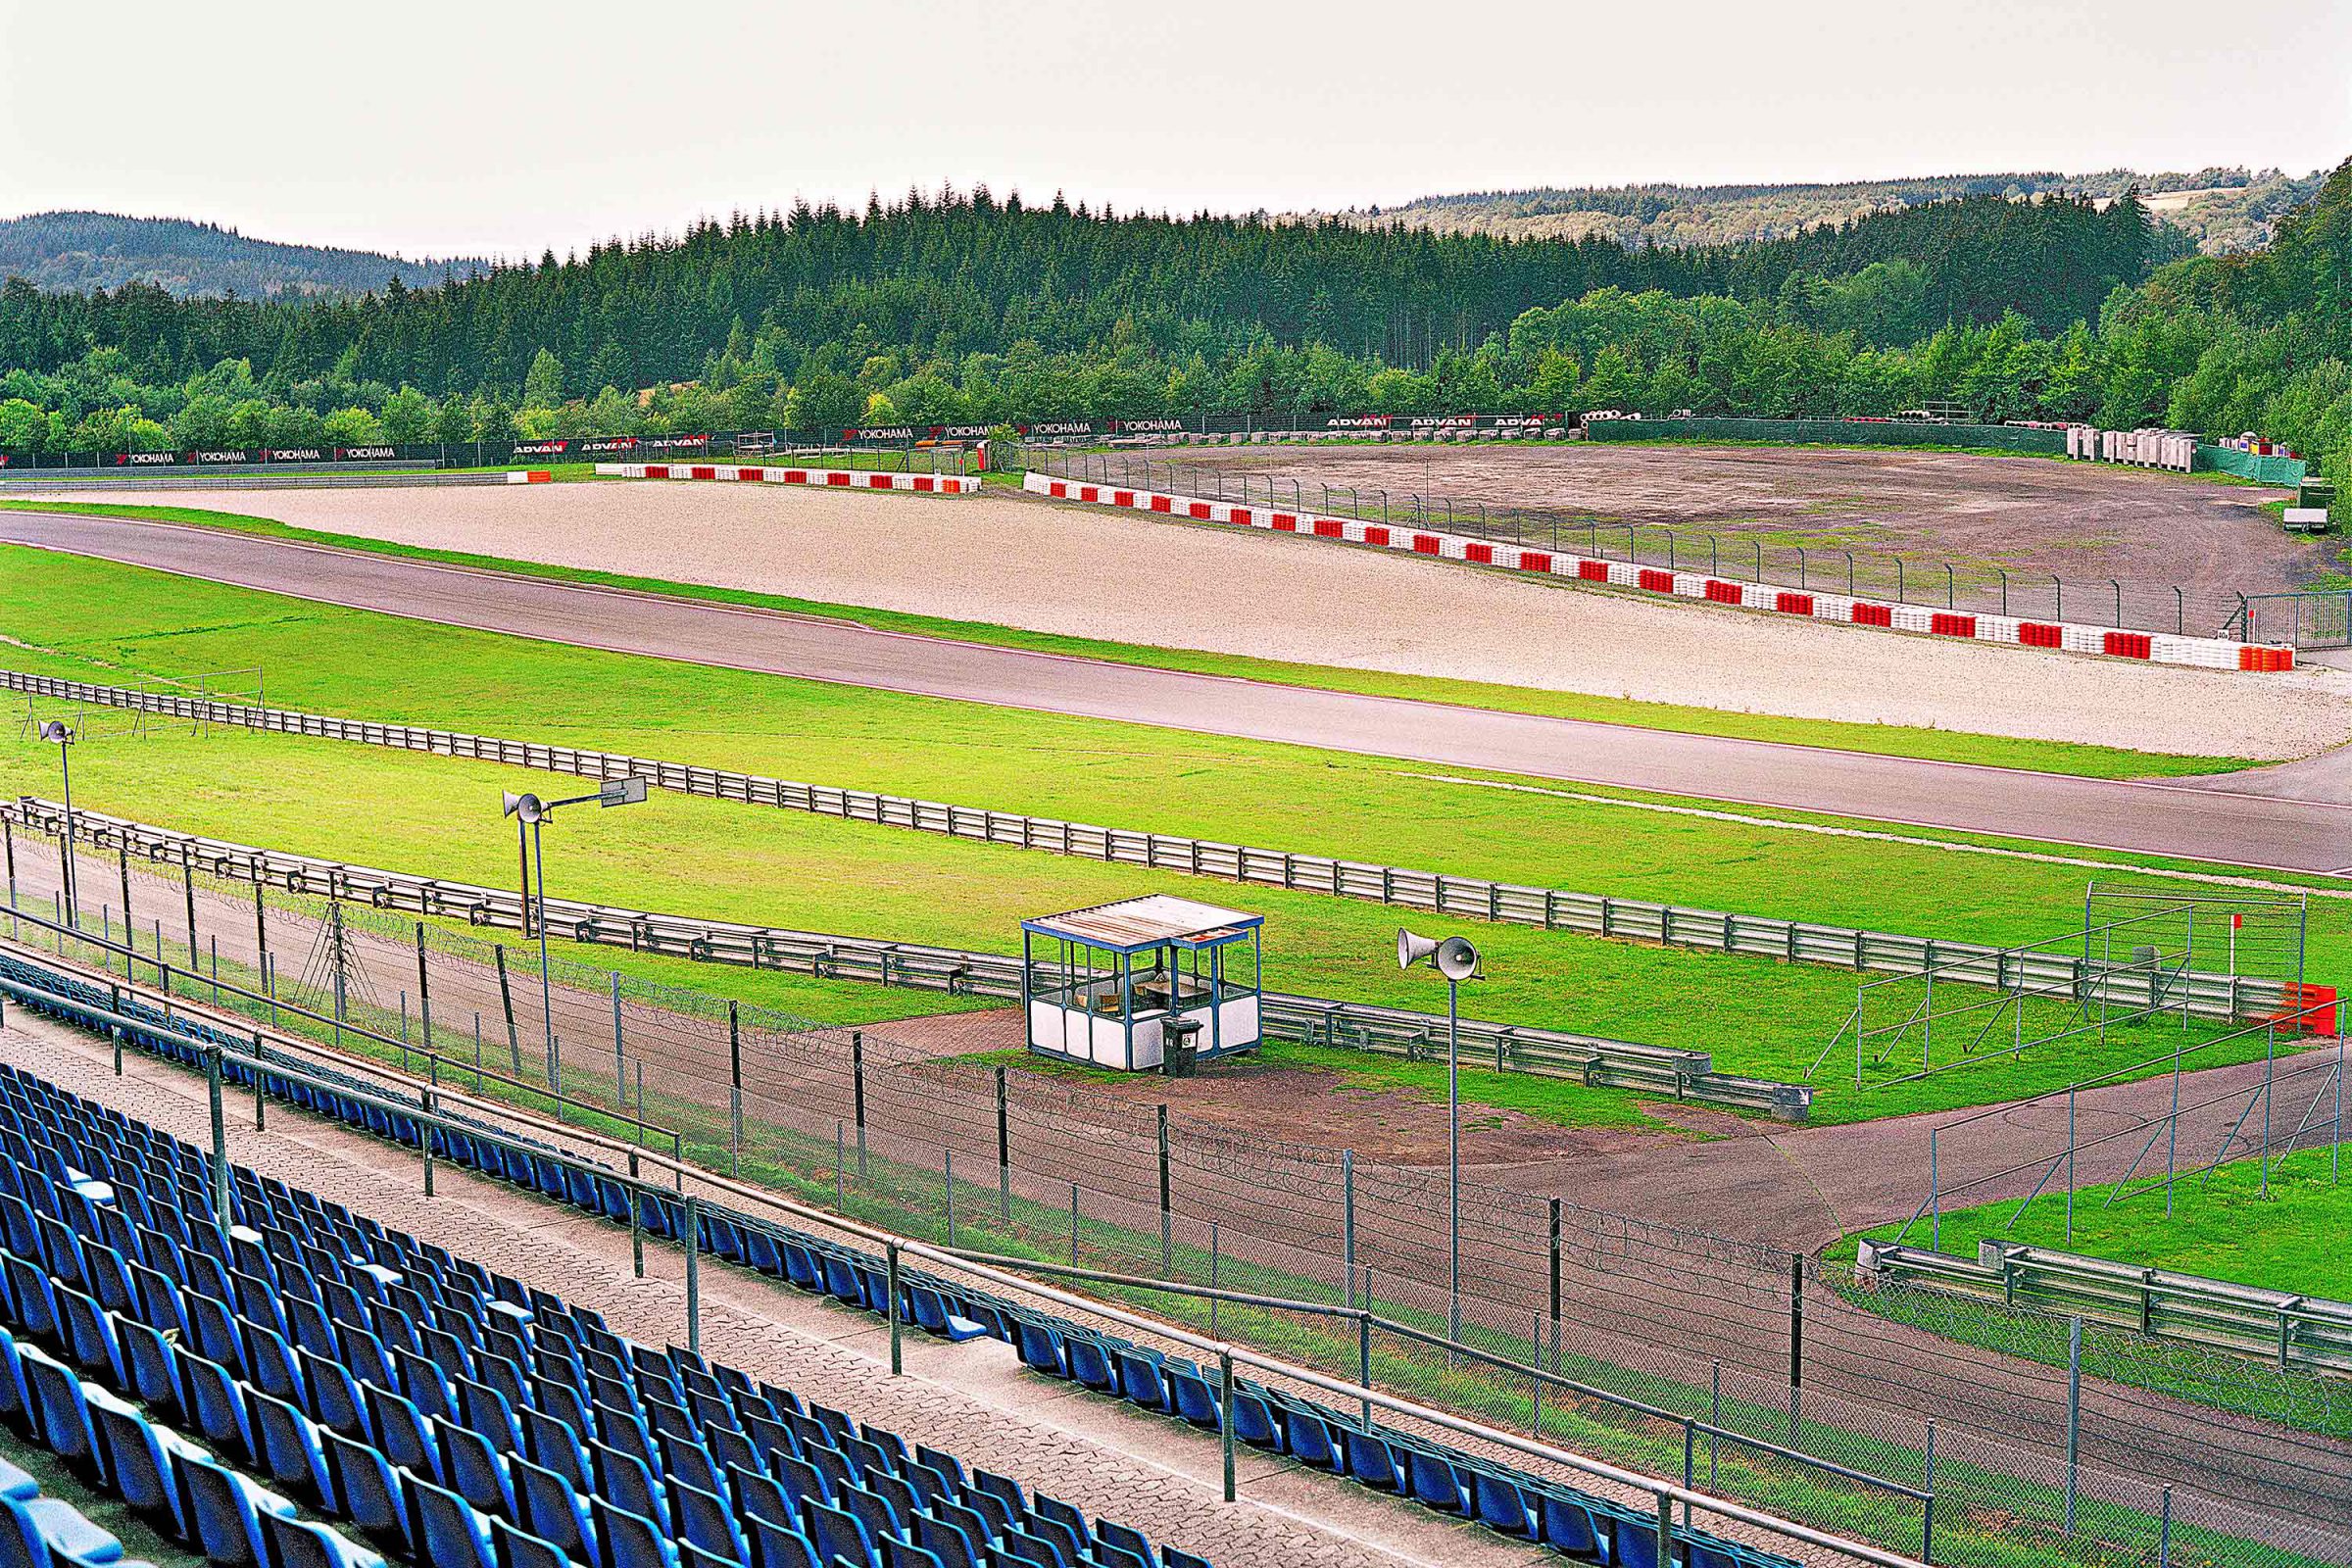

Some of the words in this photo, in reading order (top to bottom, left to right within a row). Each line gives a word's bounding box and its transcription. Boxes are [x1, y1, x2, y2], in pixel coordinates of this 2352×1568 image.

[1033, 422, 1092, 434] YOKOHAMA
[1124, 419, 1183, 431] YOKOHAMA
[858, 427, 914, 440] YOKOHAMA
[346, 447, 395, 459] YOKOHAMA
[513, 444, 564, 454] ADVAN
[581, 442, 632, 452] ADVAN
[128, 453, 174, 465] YOKOHAMA
[199, 451, 246, 463] YOKOHAMA
[272, 449, 320, 461] YOKOHAMA
